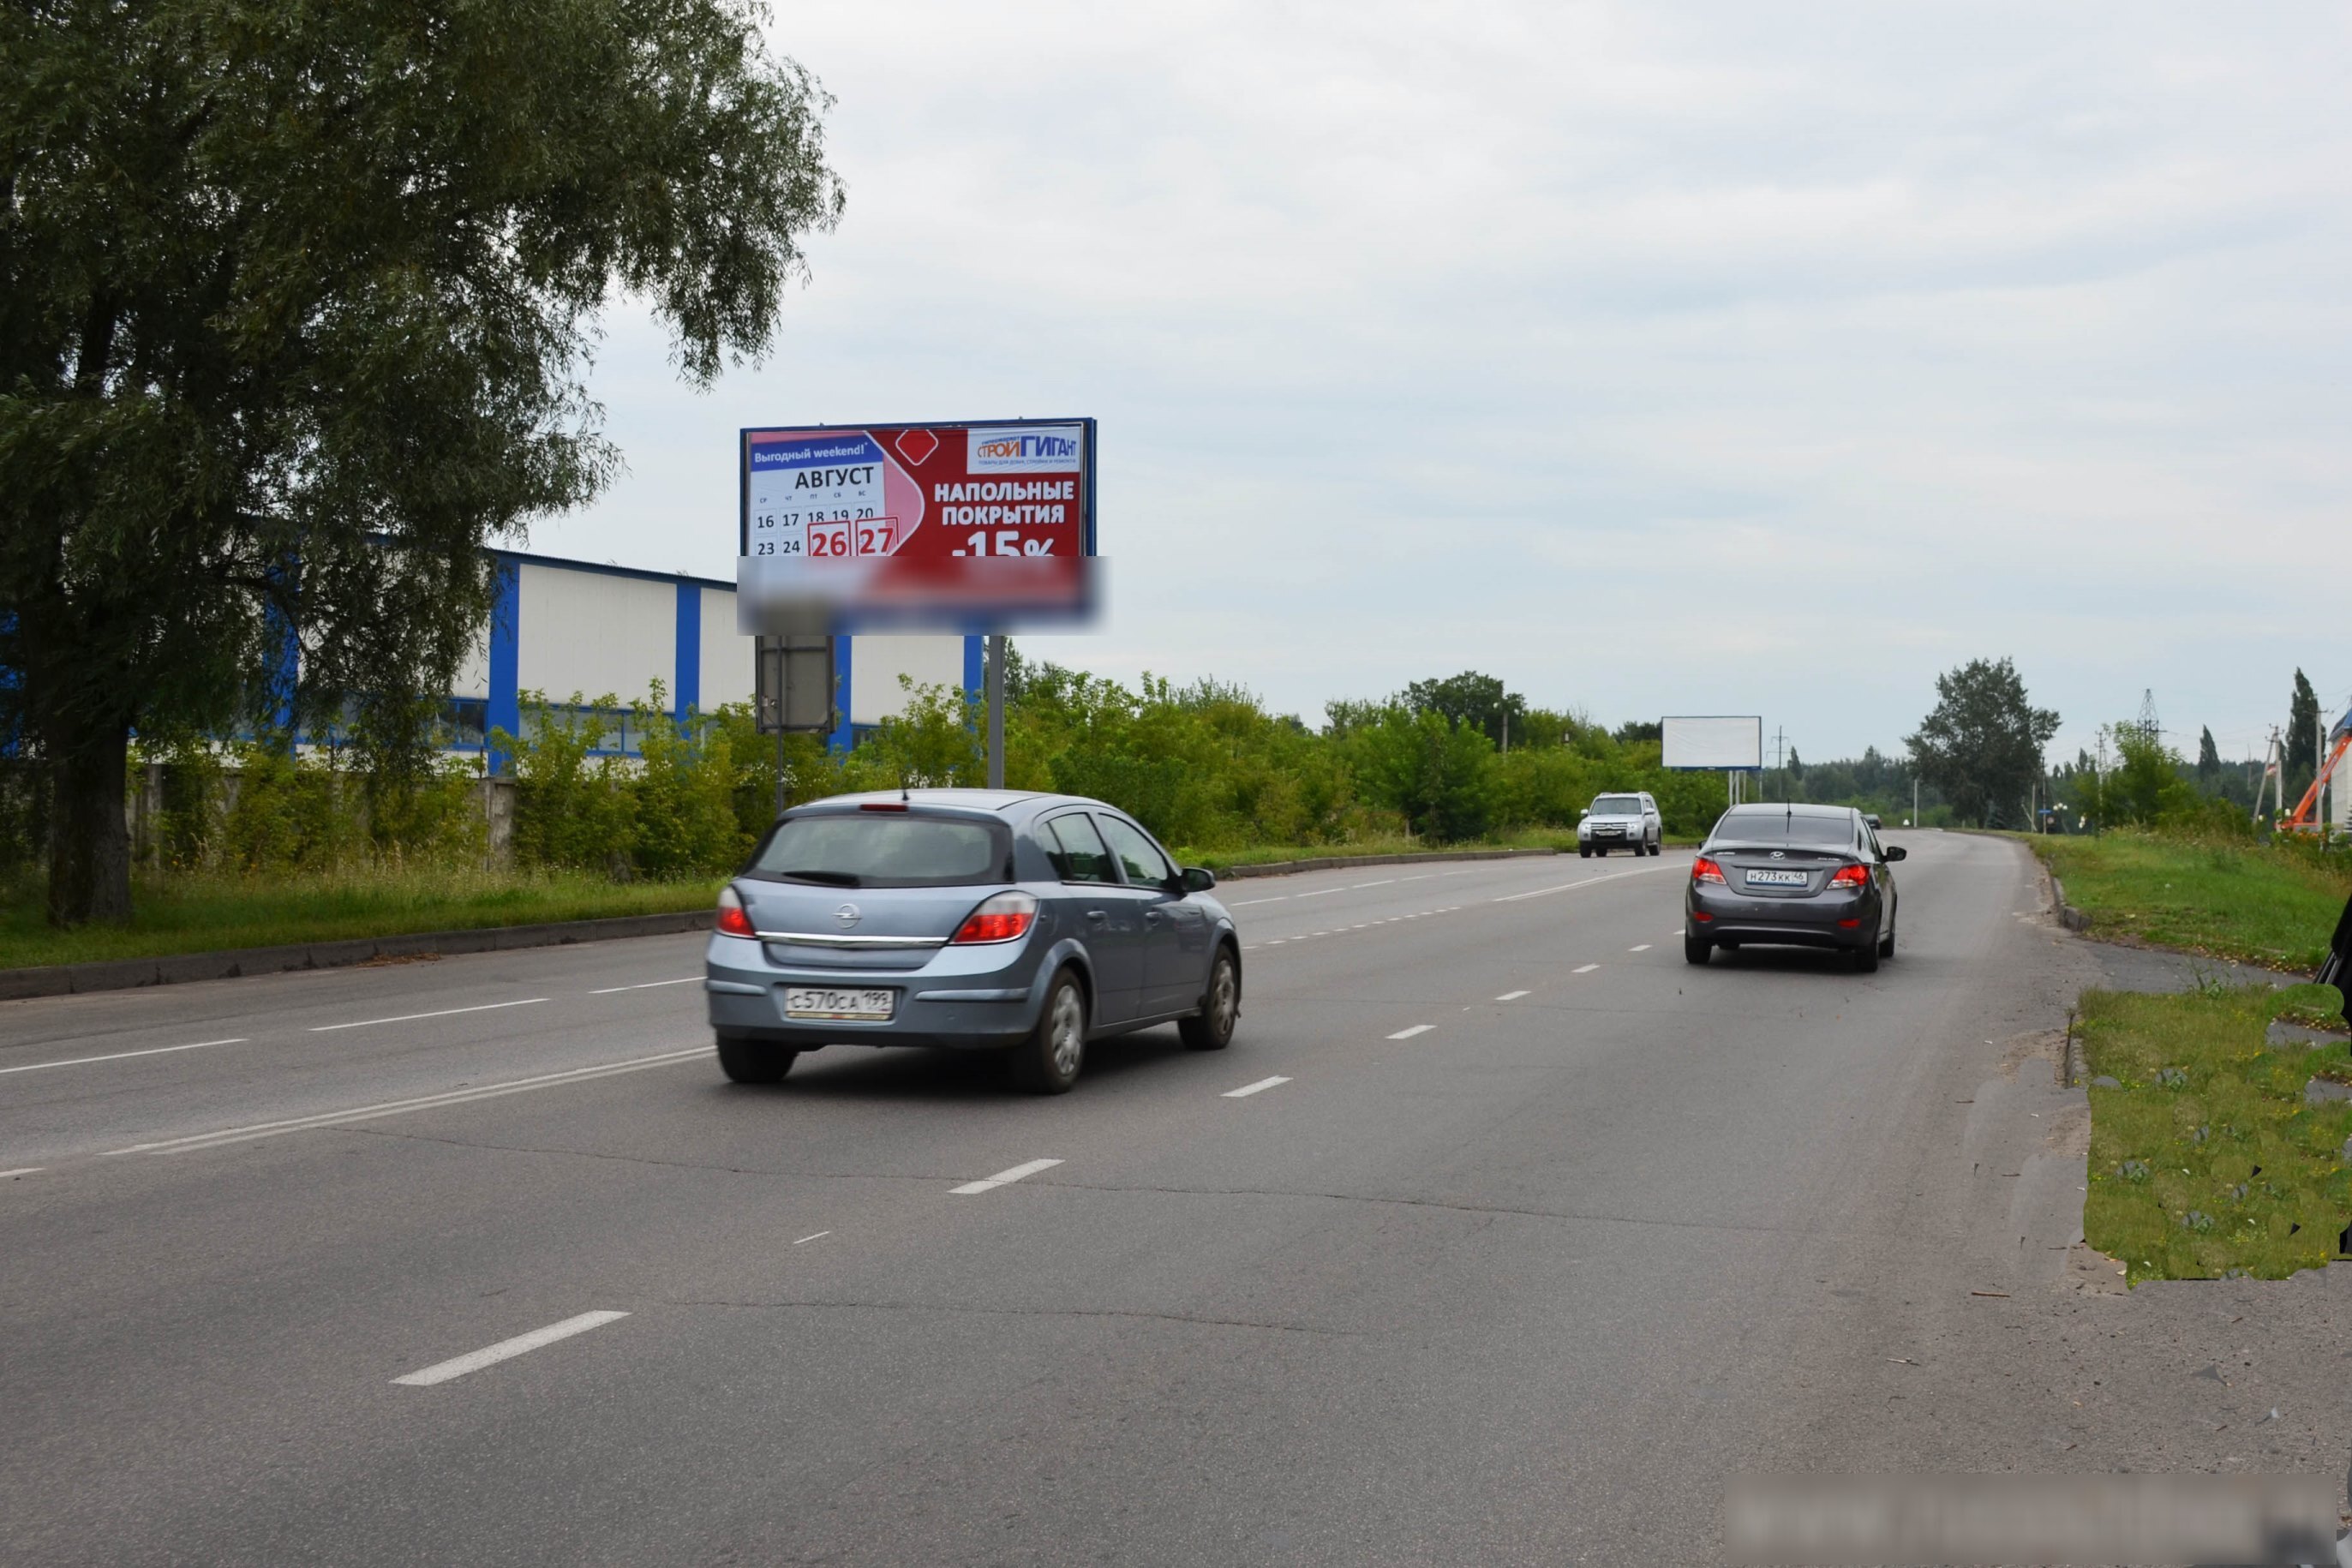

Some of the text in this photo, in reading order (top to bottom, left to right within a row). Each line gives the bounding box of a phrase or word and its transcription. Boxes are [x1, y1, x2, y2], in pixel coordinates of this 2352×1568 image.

[754, 448, 811, 463] Выгодный
[795, 466, 874, 489] АВГУСТ
[934, 481, 1074, 502] НАПОЛЬНЫЕ
[757, 515, 775, 529] 16
[782, 513, 799, 527] 17
[808, 512, 824, 522] 18
[832, 509, 849, 520] 19
[943, 505, 1064, 525] ПОКРЫТИЯ
[758, 527, 894, 556] 23 24 26 27
